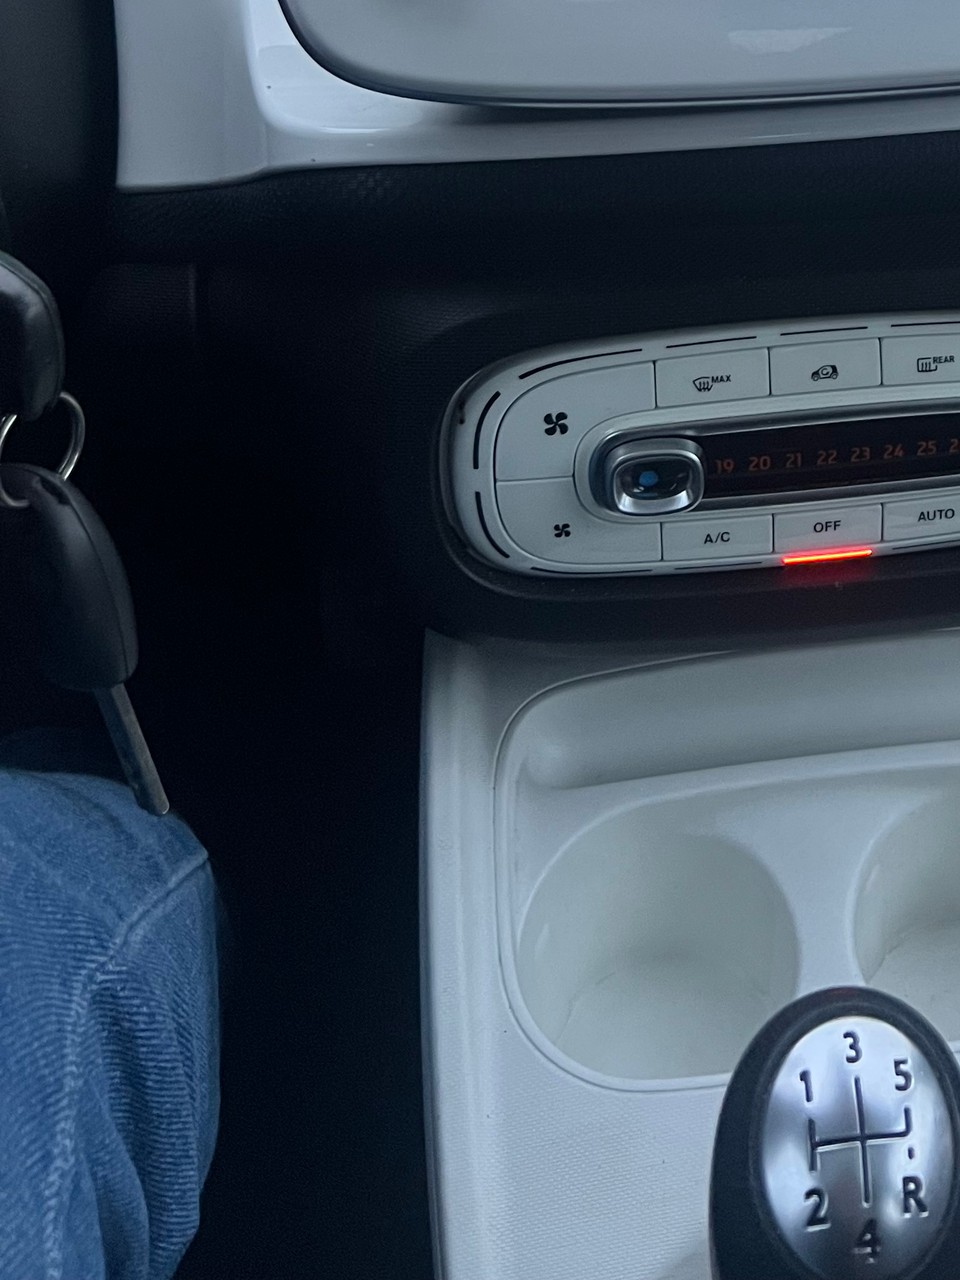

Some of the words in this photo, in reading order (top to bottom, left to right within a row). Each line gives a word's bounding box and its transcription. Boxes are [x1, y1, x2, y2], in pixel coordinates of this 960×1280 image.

[932, 354, 955, 365] REAR
[711, 373, 732, 384] MAX
[716, 458, 735, 474] 19
[748, 455, 771, 471] 20
[785, 452, 802, 468] 21
[817, 450, 837, 465] 22
[851, 447, 871, 463] 23
[883, 444, 904, 459] 24
[917, 440, 937, 456] 25
[813, 520, 841, 533] OFF
[917, 508, 955, 522] AUTO
[703, 531, 731, 545] A/C
[843, 1031, 862, 1063] 3
[799, 1069, 814, 1103] 1
[894, 1058, 913, 1091] 5
[804, 1187, 831, 1231] 2
[902, 1175, 928, 1217] R
[854, 1219, 881, 1263] 4
